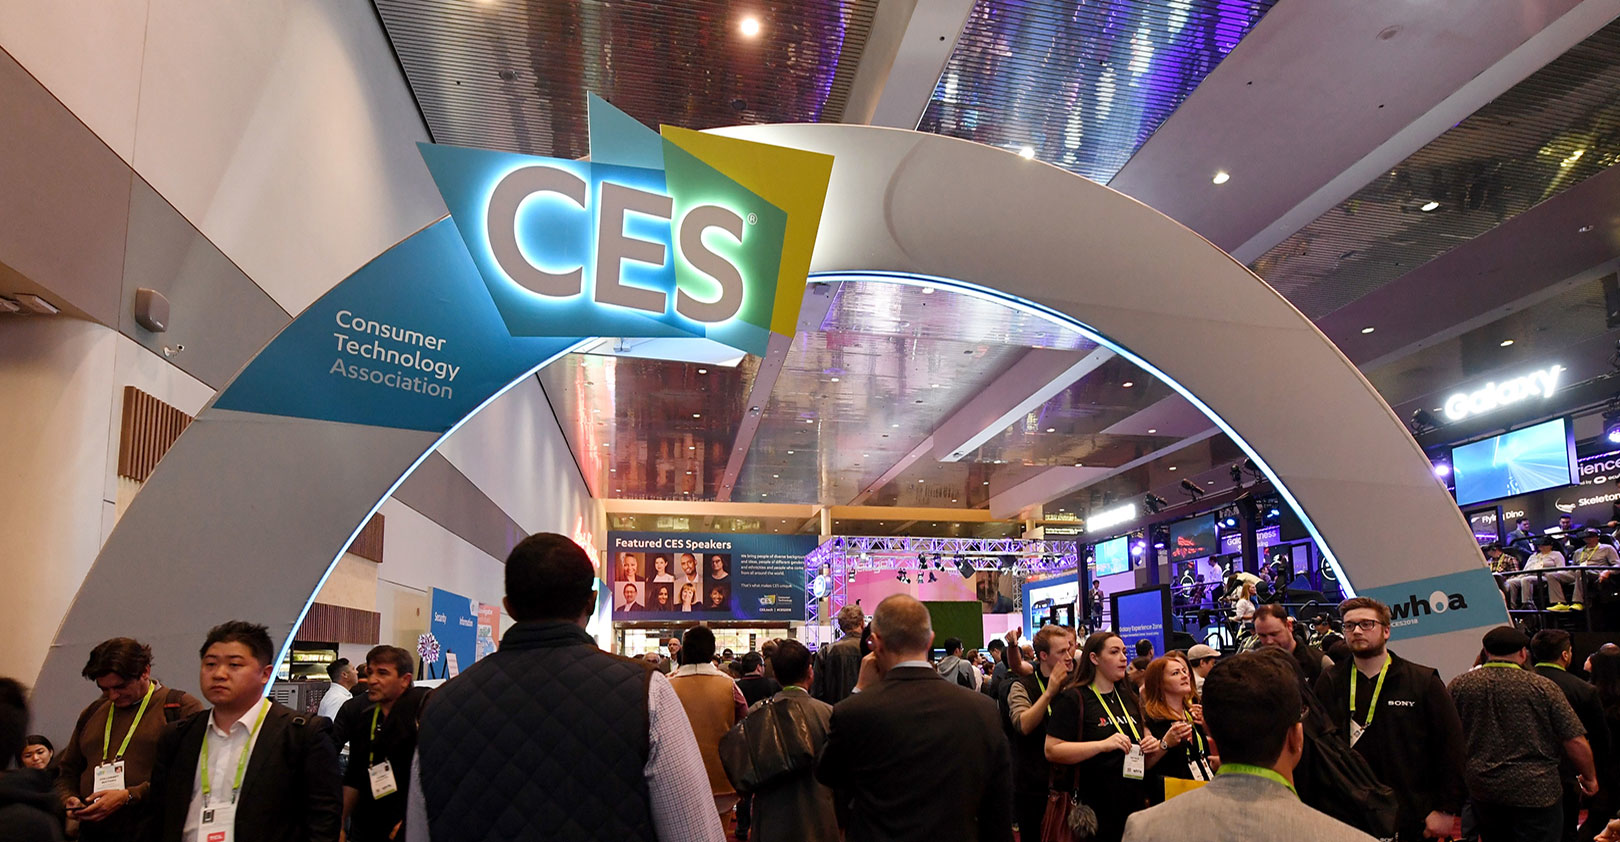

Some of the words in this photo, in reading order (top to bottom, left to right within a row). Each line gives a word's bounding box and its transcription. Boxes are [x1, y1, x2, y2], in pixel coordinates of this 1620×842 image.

[335, 309, 447, 351] Consumer
[333, 332, 461, 382] Technology
[329, 357, 453, 400] Association
[1444, 365, 1561, 420] Galaxy
[1505, 510, 1525, 520] Dino
[615, 538, 662, 549] Featured
[664, 538, 684, 549] CES
[685, 539, 732, 551] Speakers
[1389, 590, 1468, 621] whoa
